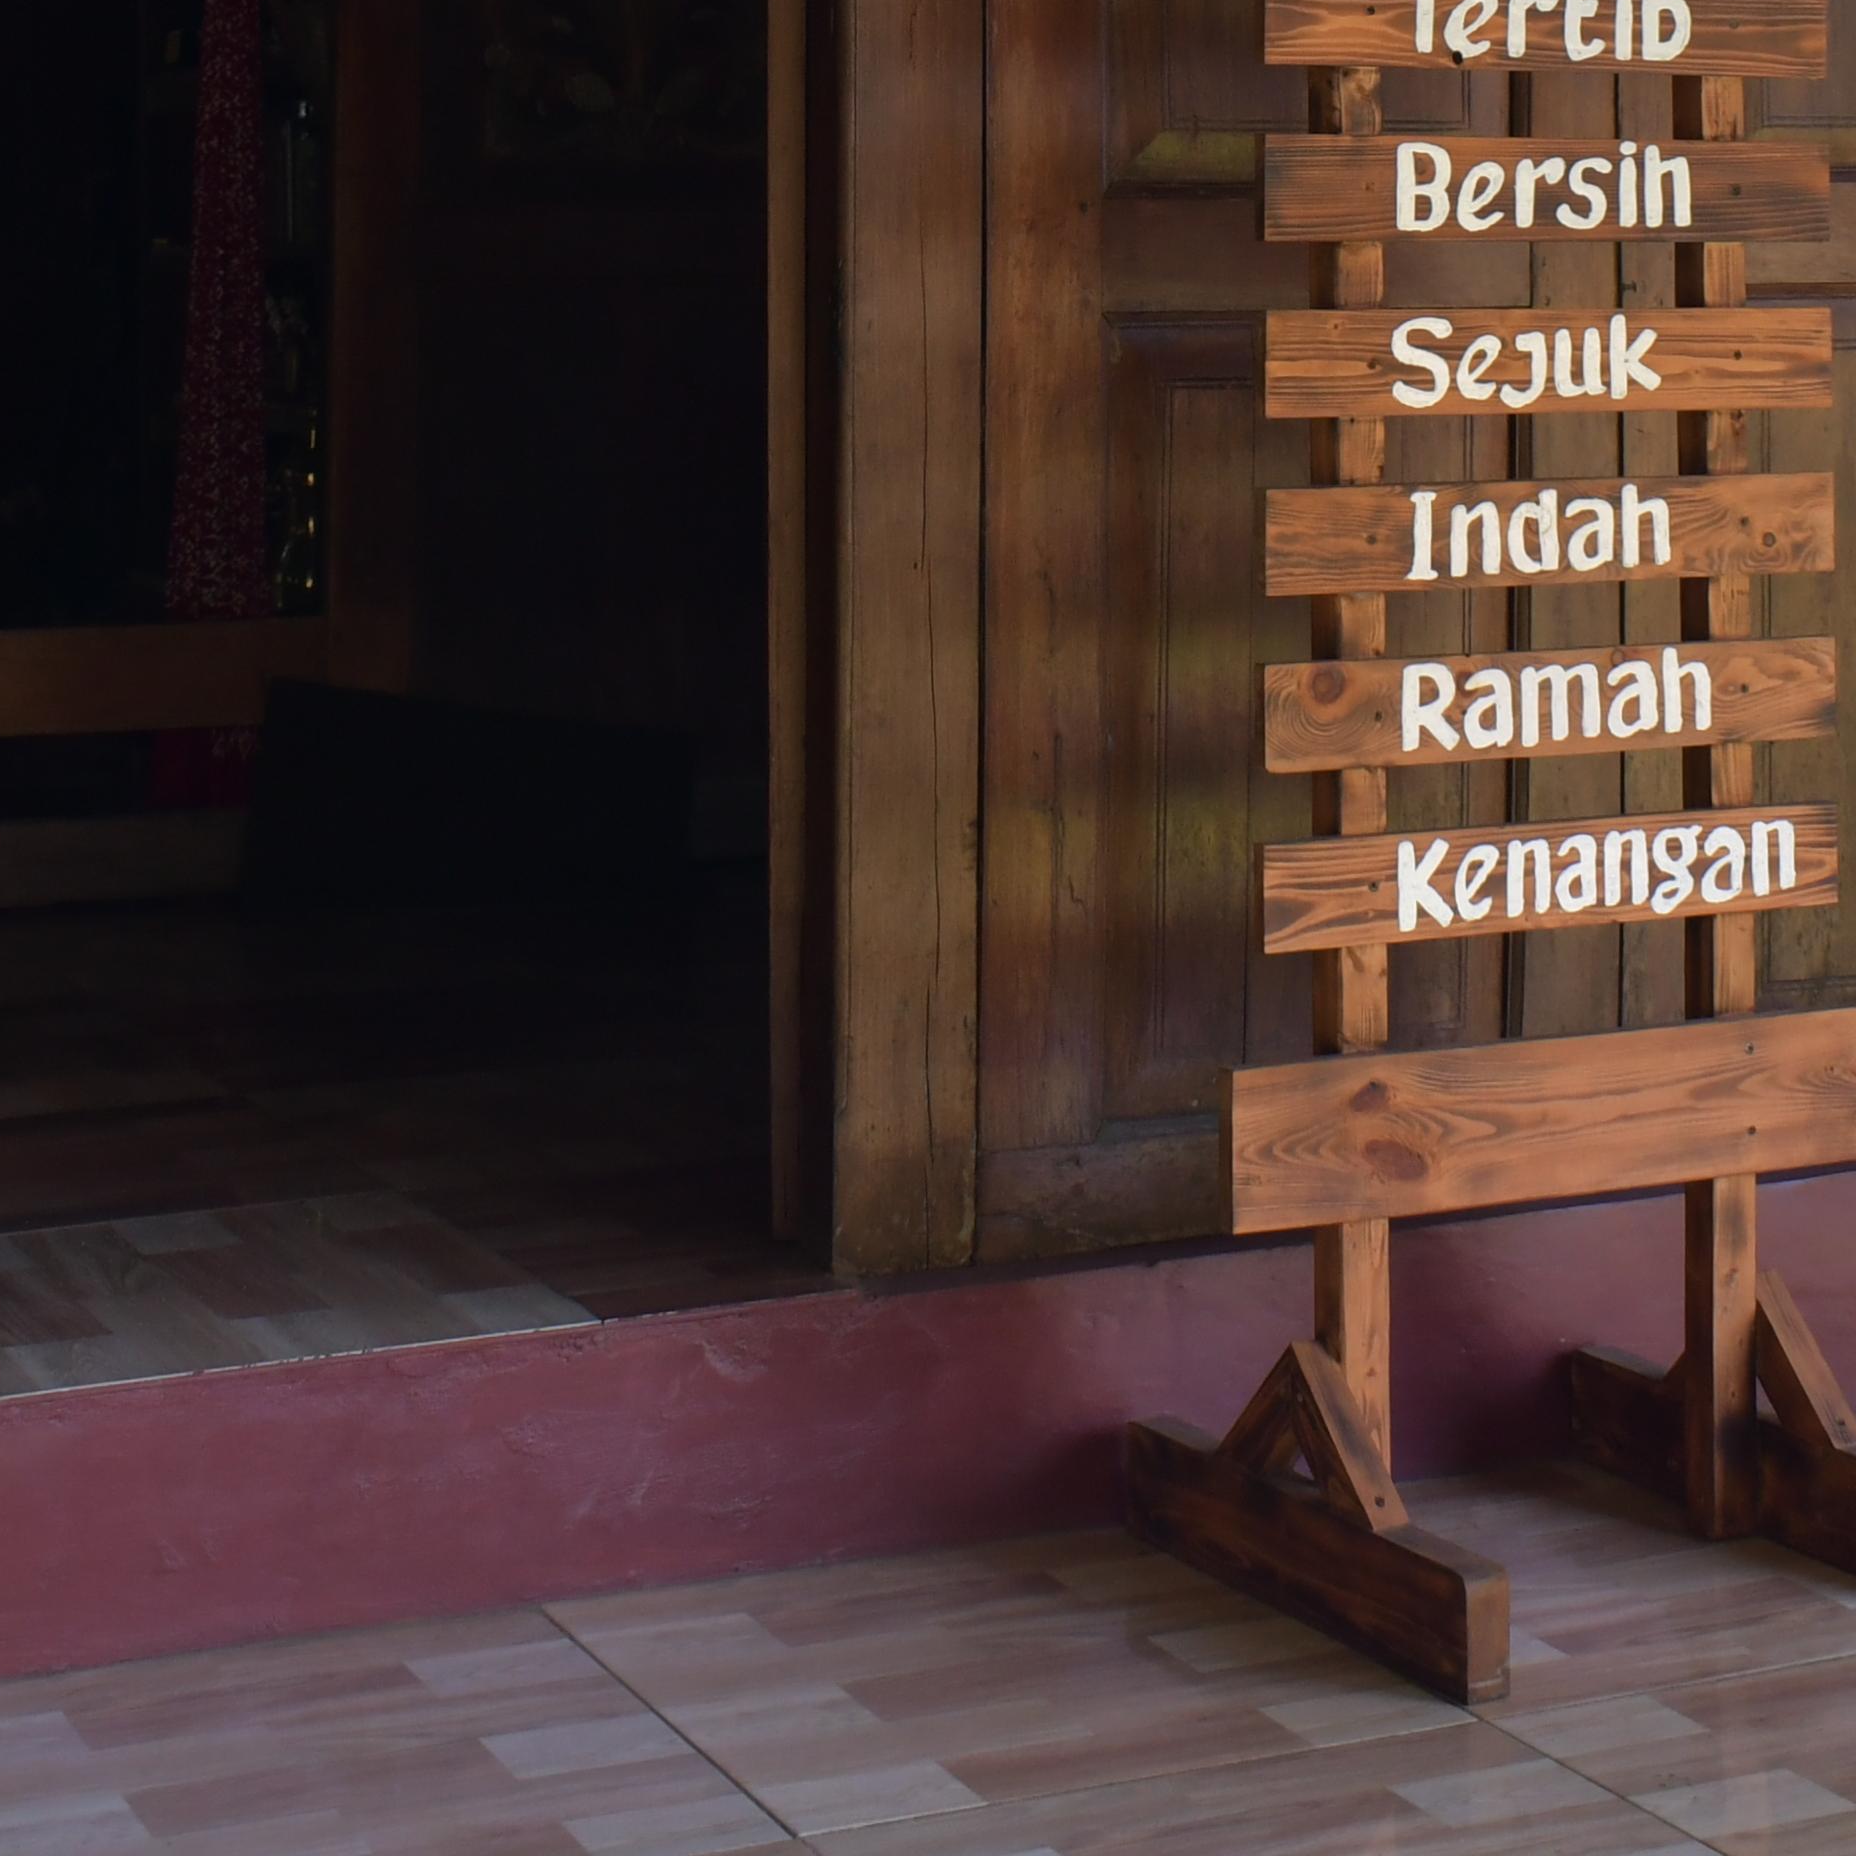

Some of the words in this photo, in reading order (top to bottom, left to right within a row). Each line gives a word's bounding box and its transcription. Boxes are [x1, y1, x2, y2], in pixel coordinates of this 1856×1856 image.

[1396, 141, 1692, 232] Bersih
[1406, 484, 1672, 581] Indah
[1401, 647, 1712, 752] Ramah
[1396, 819, 1797, 933] Kenangan
